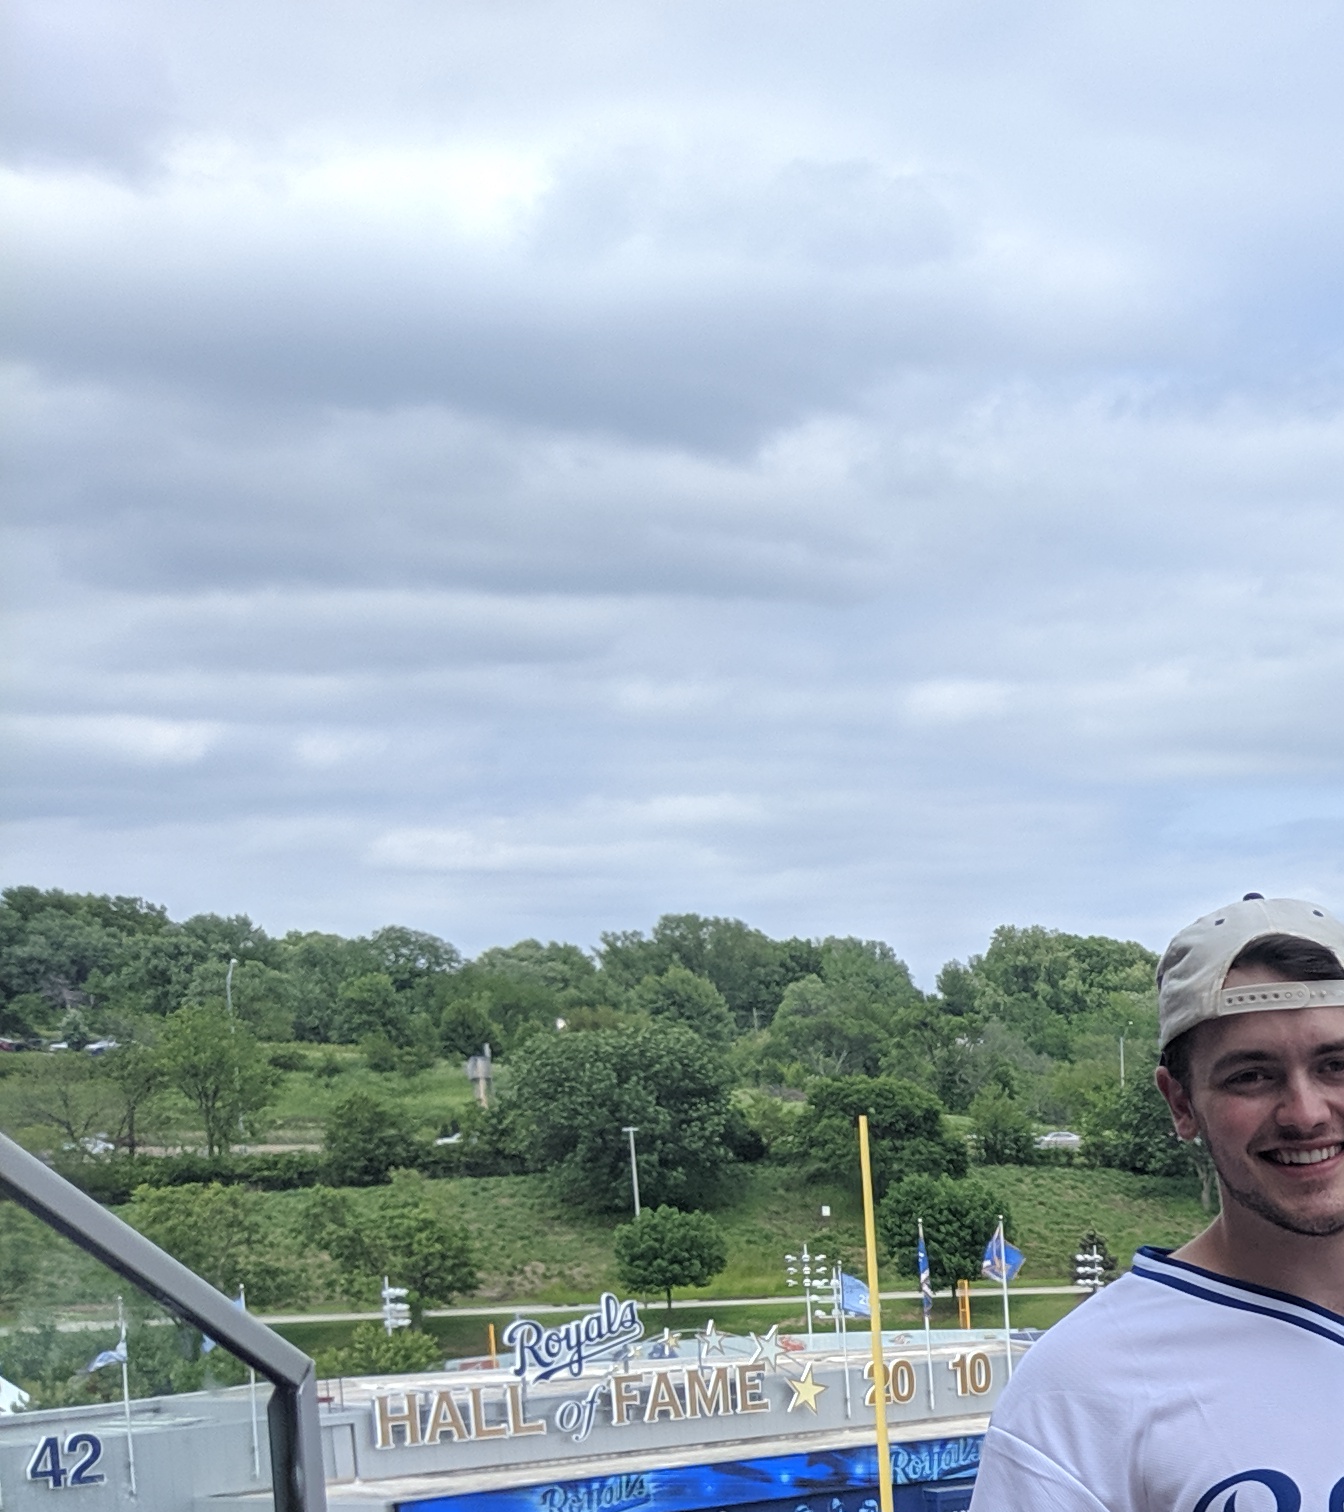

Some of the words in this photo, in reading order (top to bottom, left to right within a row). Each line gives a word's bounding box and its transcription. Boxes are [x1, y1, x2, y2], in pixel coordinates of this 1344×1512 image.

[503, 1292, 645, 1385] Royals
[373, 1385, 547, 1450] HALL
[555, 1385, 606, 1443] of
[609, 1362, 771, 1427] FAME
[948, 1350, 993, 1397] 10
[26, 1432, 107, 1490] 42
